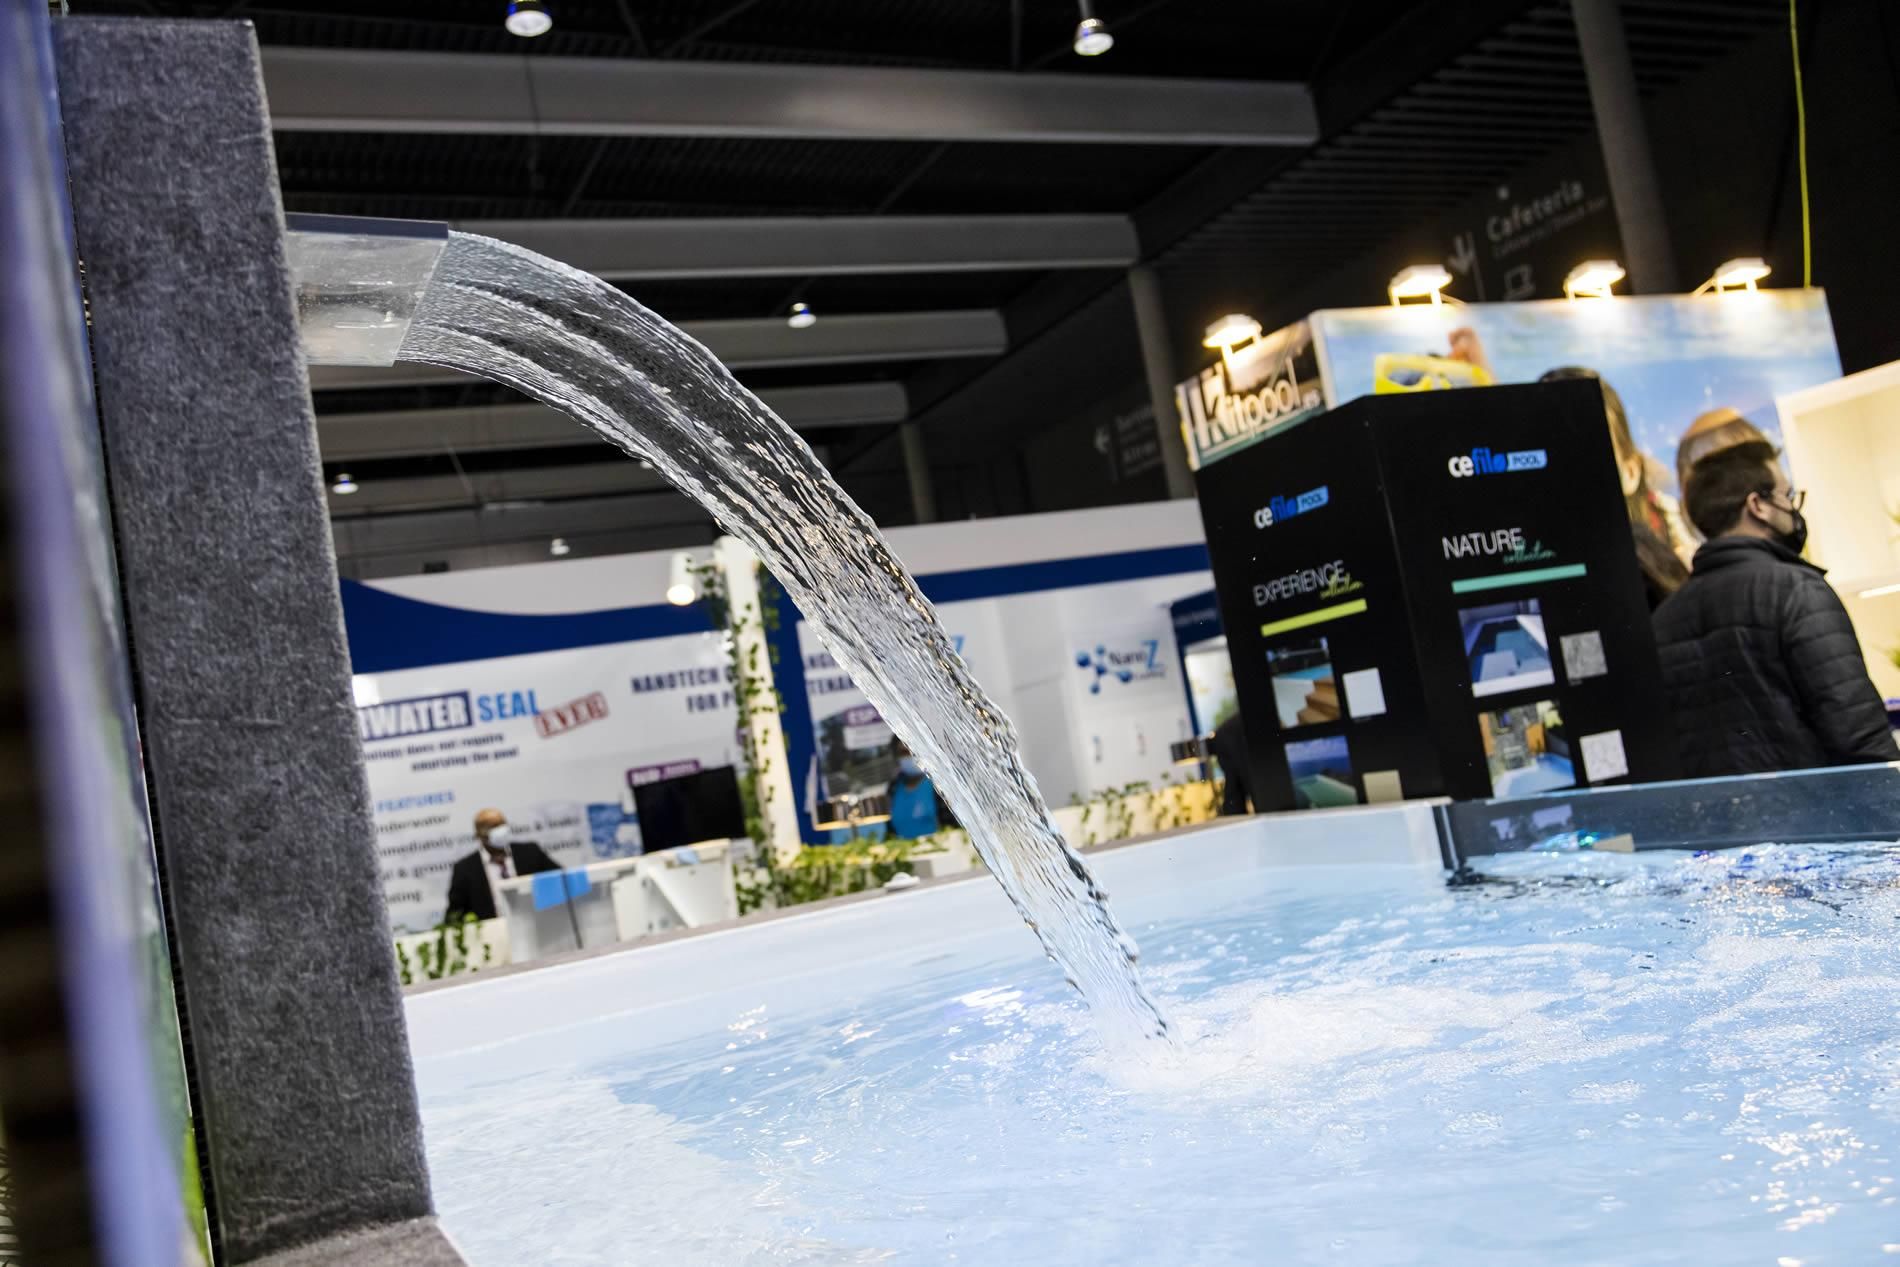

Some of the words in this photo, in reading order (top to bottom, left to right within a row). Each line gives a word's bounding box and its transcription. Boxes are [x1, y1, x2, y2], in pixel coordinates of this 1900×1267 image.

[1441, 527, 1522, 560] NATURE
[1252, 560, 1345, 606] EXPERIENCE
[631, 668, 719, 693] NANOTECH
[478, 689, 541, 722] SEAL
[541, 696, 603, 735] EVER
[687, 693, 717, 713] FOR
[376, 791, 455, 812] FEATURES
[376, 815, 450, 833] nderwater
